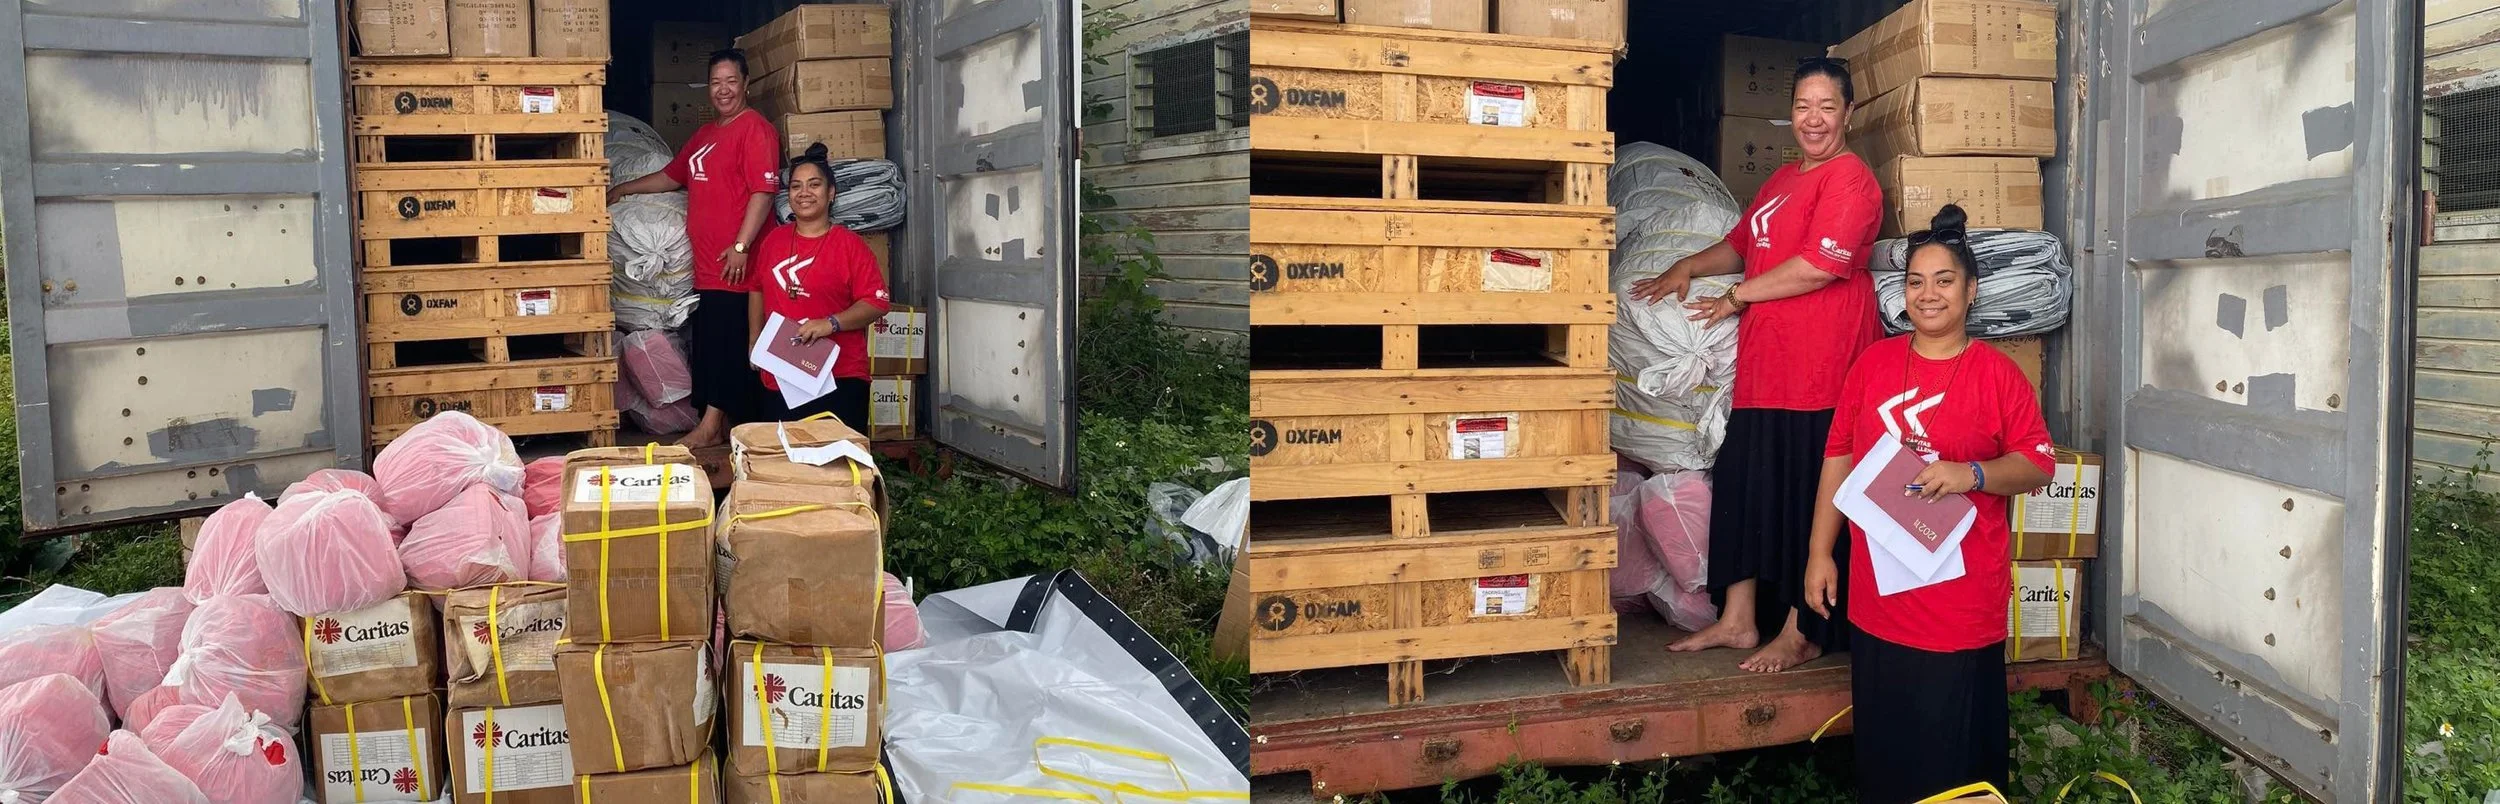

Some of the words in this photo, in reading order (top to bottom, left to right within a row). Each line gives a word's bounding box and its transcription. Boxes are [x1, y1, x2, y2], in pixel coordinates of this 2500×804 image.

[420, 97, 453, 109] OXFAM
[1287, 88, 1346, 107] OXFAM
[424, 200, 456, 211] OXFAM
[1286, 262, 1344, 280] OXFAM
[426, 299, 458, 309] OXFAM
[889, 324, 924, 336] Carias
[440, 400, 472, 411] OXFAM
[1286, 429, 1342, 444] OXFAM
[620, 474, 690, 487] Carias
[2047, 481, 2096, 499] Carias
[1305, 600, 1361, 619] OXFAM
[344, 621, 410, 643] Caritas
[505, 726, 570, 750] Caritas
[327, 767, 391, 786] Cartas
